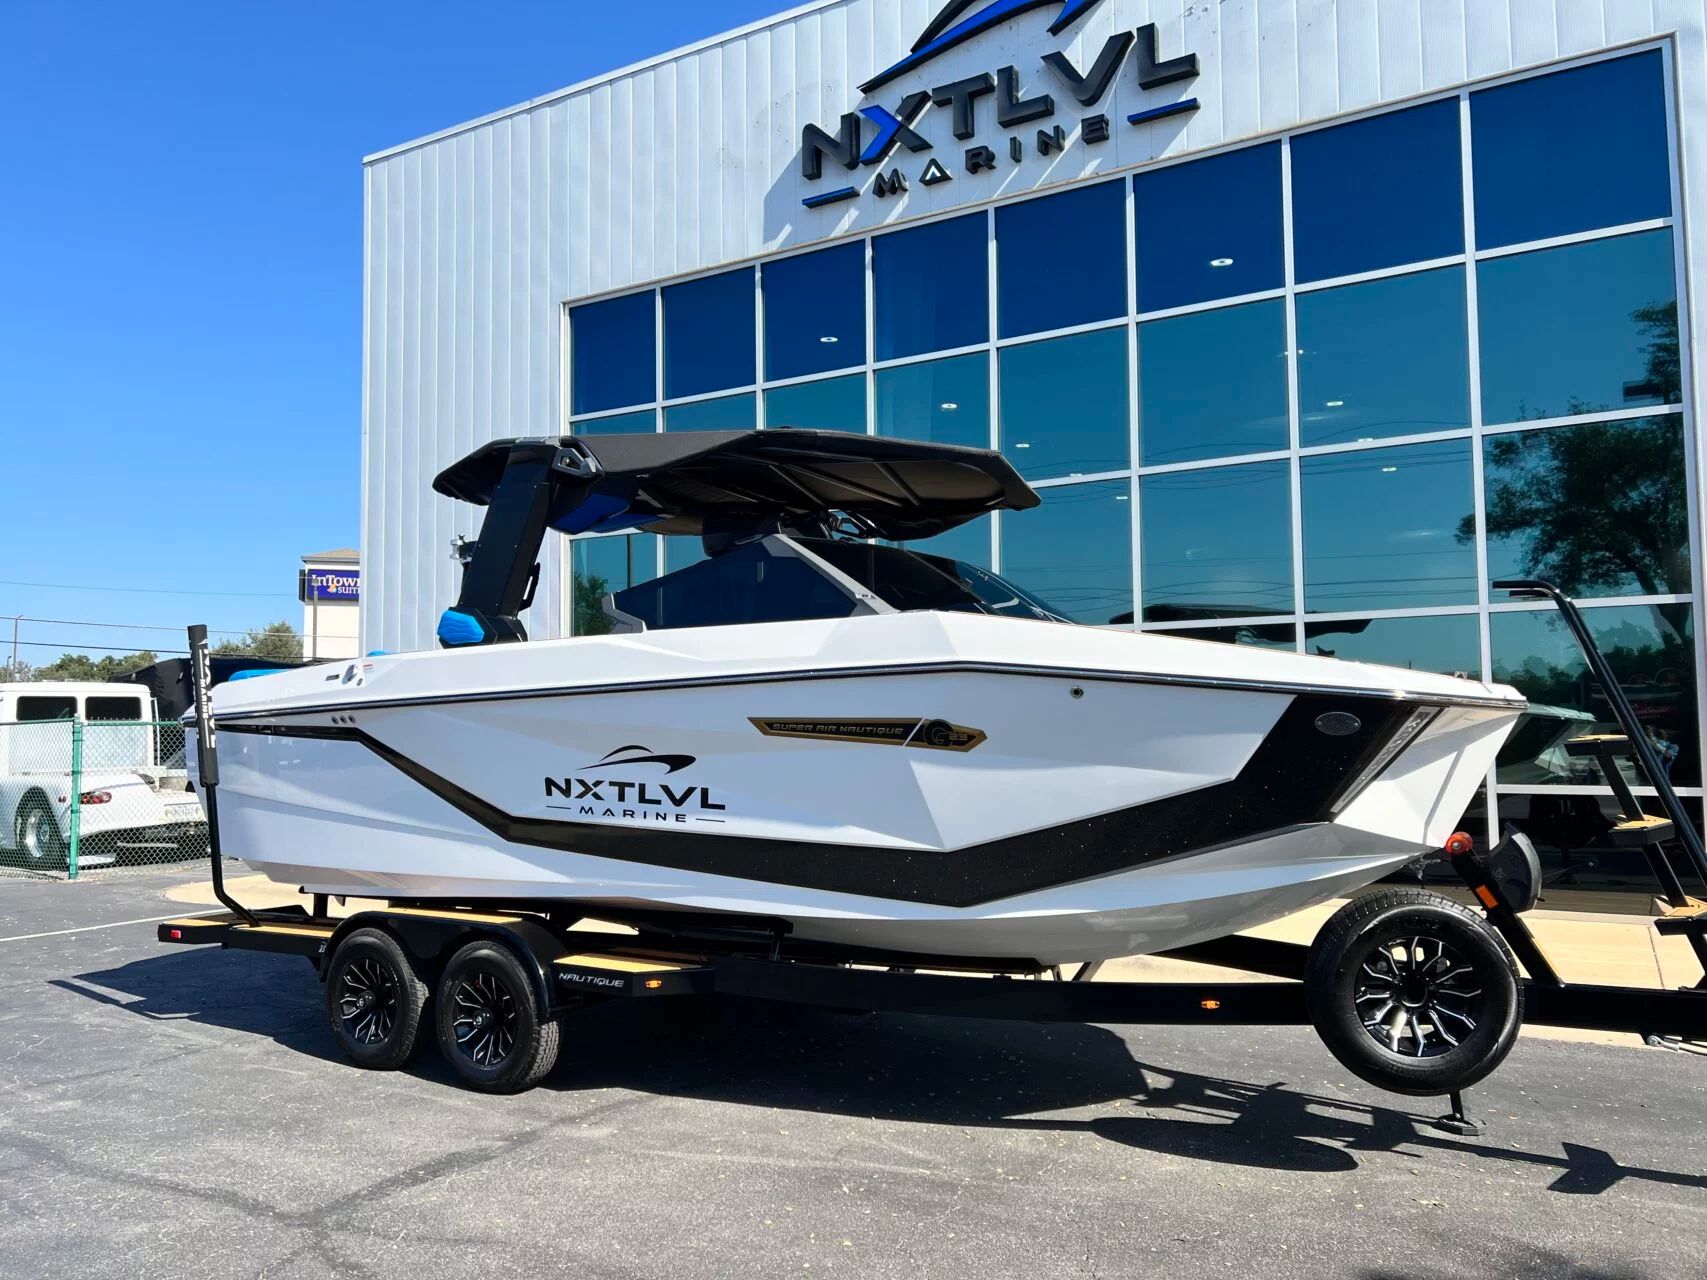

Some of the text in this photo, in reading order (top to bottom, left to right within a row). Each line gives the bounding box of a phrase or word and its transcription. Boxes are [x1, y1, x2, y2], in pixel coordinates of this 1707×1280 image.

[802, 22, 1200, 181] NXTLVL
[872, 114, 1110, 198] MARINE
[772, 723, 905, 735] SUPER AIR NAUTIQUE
[545, 777, 726, 811] NXTLVL
[579, 806, 687, 823] MARINE
[558, 972, 625, 988] NAUTIQUE
